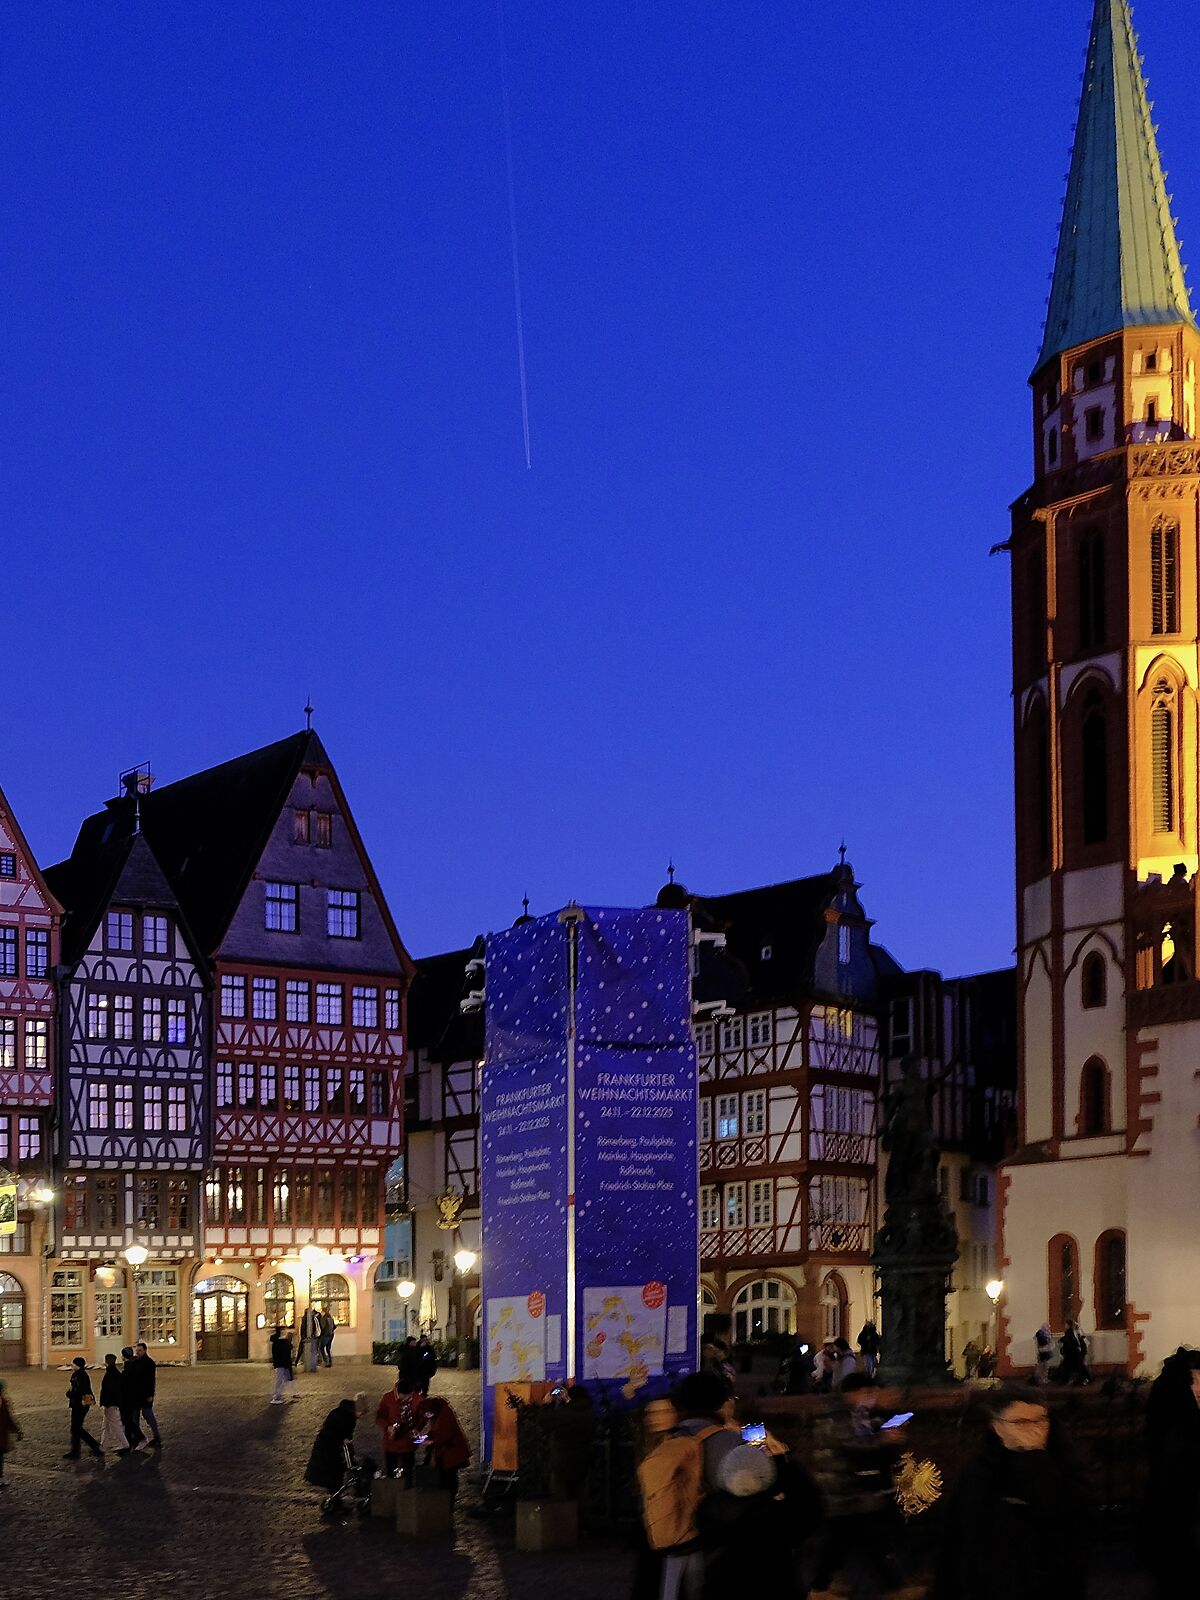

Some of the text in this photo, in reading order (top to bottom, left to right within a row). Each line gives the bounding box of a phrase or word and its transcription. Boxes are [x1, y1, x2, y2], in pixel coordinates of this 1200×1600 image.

[597, 1072, 676, 1087] FRANKFURTER
[495, 1082, 552, 1107] FRANKFURTER
[578, 1088, 694, 1102] WEIHNACHTSMARKT
[483, 1093, 566, 1123] WEIHNACHTSMARKT
